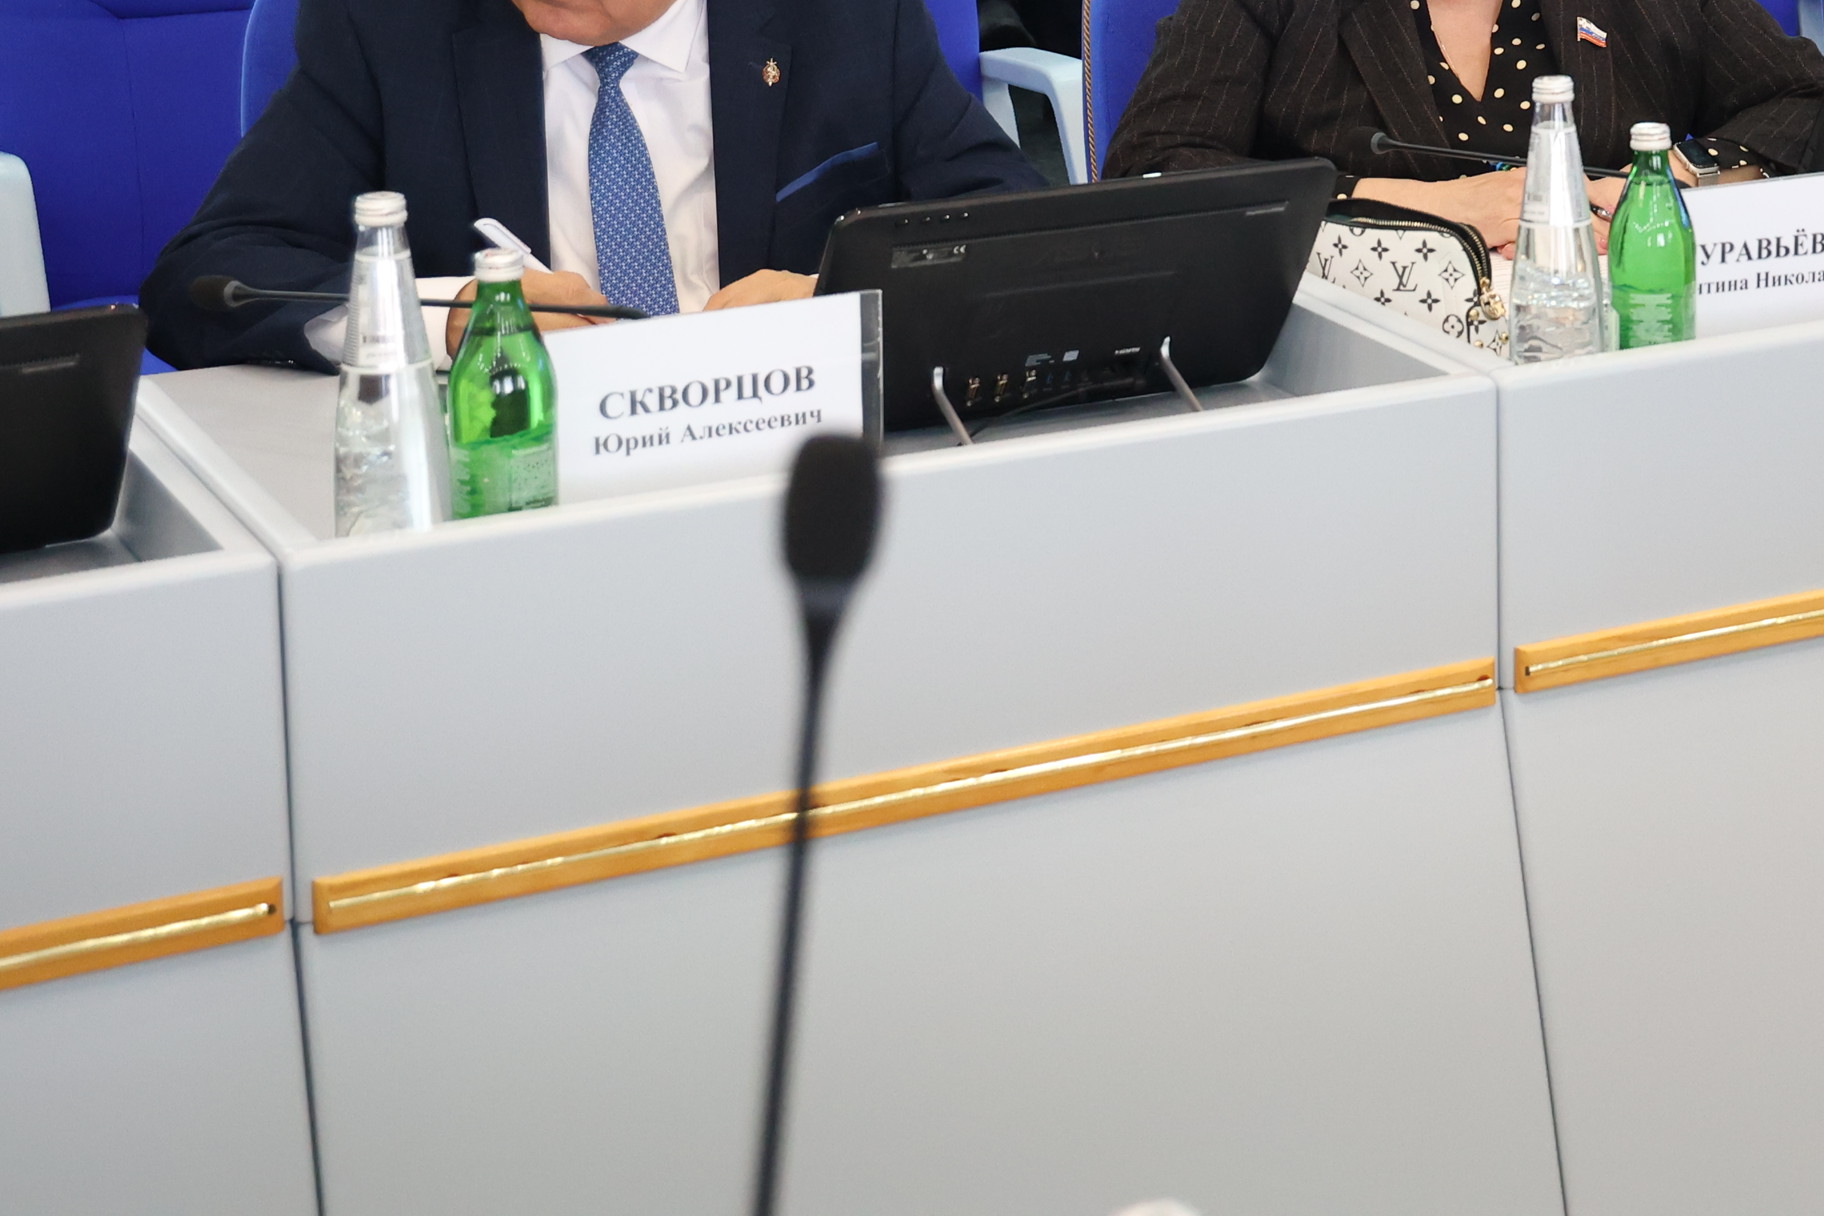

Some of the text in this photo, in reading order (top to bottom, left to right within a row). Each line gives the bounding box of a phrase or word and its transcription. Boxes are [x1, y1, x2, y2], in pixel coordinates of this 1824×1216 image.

[598, 364, 816, 420] СКВОРЦОВ
[593, 408, 823, 456] Юрий Алексеевич
